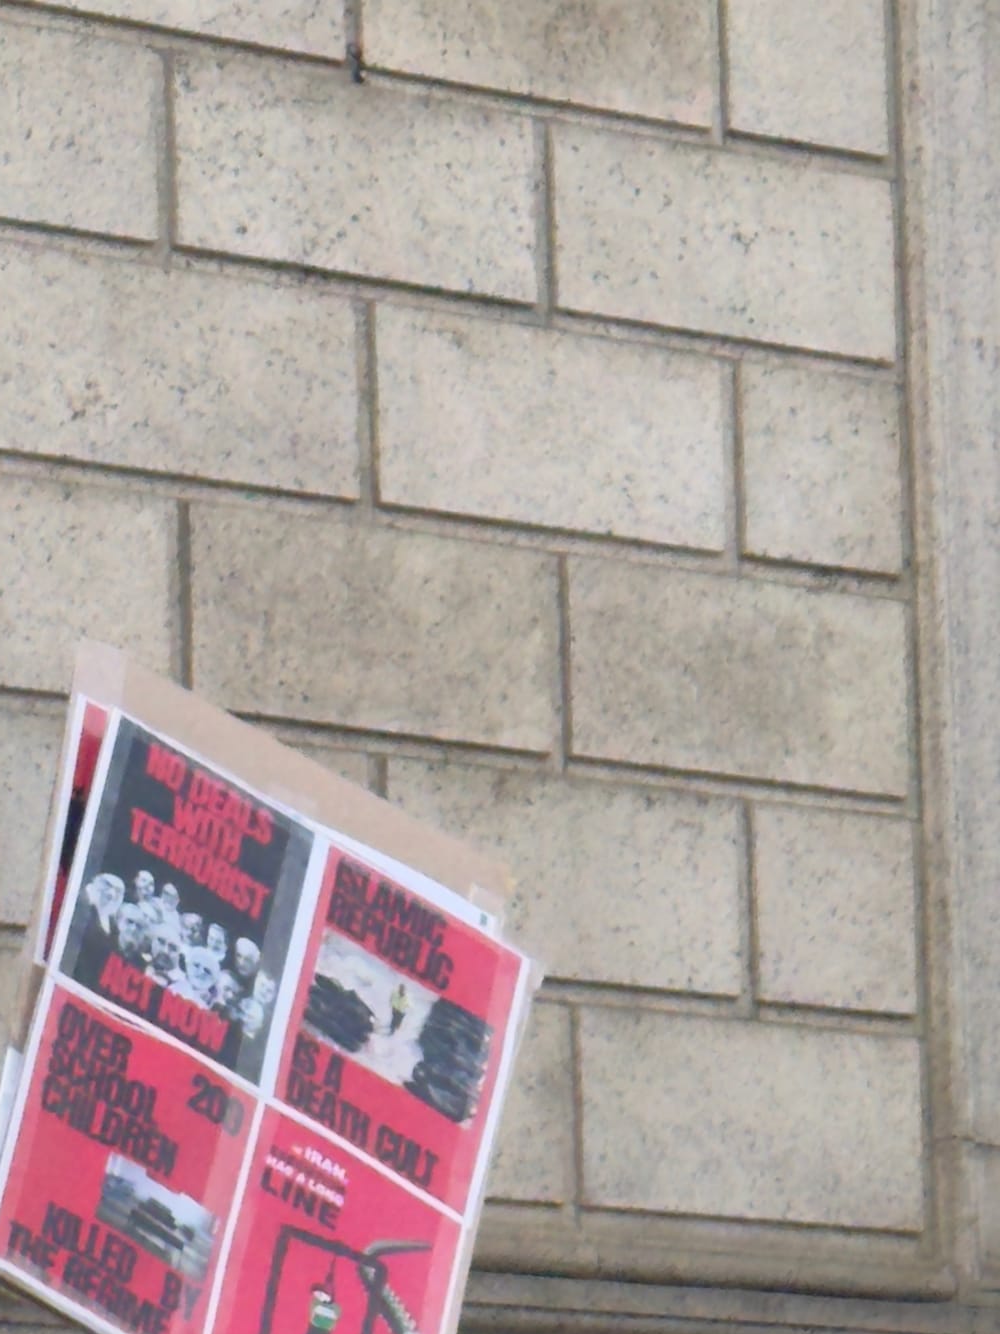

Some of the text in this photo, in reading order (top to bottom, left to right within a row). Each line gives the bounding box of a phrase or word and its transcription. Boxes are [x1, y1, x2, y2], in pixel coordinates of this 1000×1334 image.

[145, 743, 274, 846] NO DEALS
[173, 794, 242, 863] WITH
[130, 806, 271, 920] TERRORIST
[334, 856, 447, 948] ISLAMIC
[326, 891, 454, 990] REPUBLIC
[100, 950, 230, 1053] ACT NOW
[49, 1037, 157, 1124] SCHOOL
[57, 1001, 245, 1137] OVER 200
[292, 1032, 345, 1095] IS A
[41, 1072, 179, 1179] CHILDREN
[285, 1070, 371, 1150] DEATH
[374, 1123, 440, 1187] CULT
[8, 1221, 58, 1270] THE
[261, 1165, 343, 1231] LINE
[42, 1203, 202, 1321] KILLED BY
